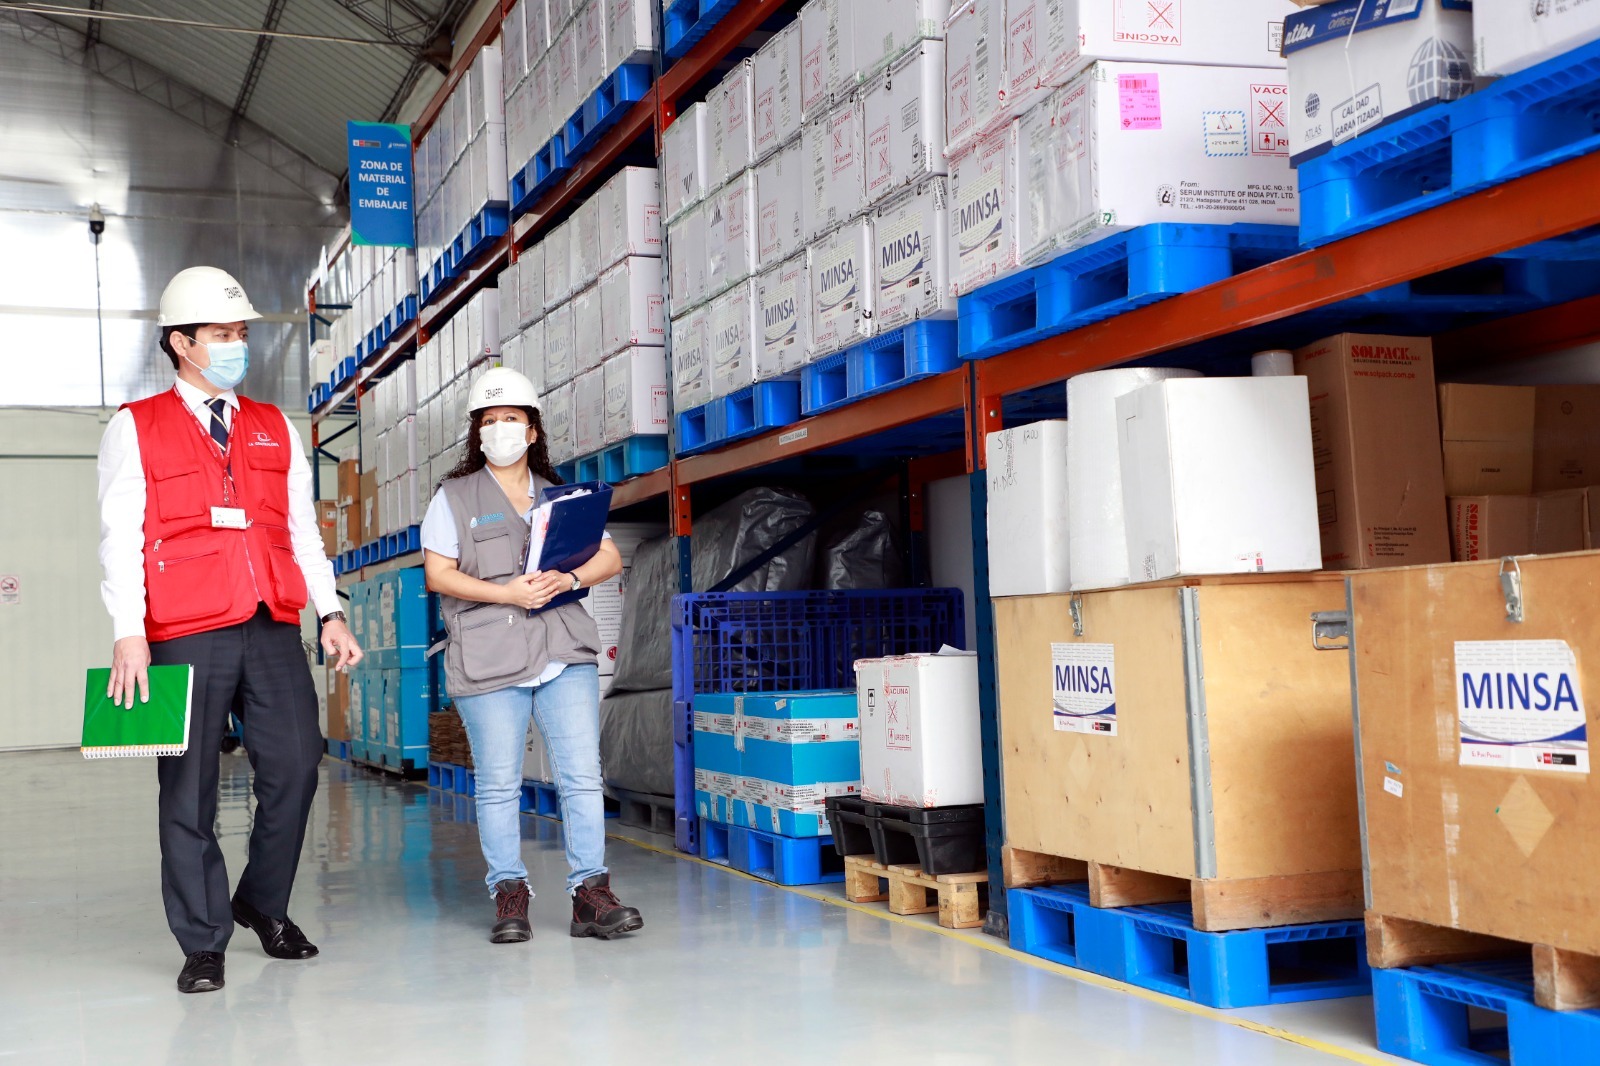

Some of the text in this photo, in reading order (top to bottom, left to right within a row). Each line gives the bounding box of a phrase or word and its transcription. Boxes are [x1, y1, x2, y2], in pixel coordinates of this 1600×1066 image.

[1012, 22, 1026, 36] RUSH
[1284, 23, 1316, 45] atlas
[1328, 16, 1353, 30] Office
[1116, 32, 1179, 44] VACCINE
[1012, 65, 1036, 87] VACCINE
[1062, 86, 1086, 108] ACCINE
[1305, 124, 1322, 138] ATLAS
[360, 160, 403, 171] ZONA DE
[358, 173, 406, 184] MATERIAL
[376, 187, 389, 196] DE
[358, 198, 408, 210] EMBALAJE
[960, 187, 1000, 234] MINSA
[882, 230, 921, 269] MINSA
[820, 258, 855, 293] MINSA
[765, 297, 795, 328] MINSA
[715, 323, 740, 352] MINSA
[678, 347, 702, 373] MINSA
[1352, 345, 1410, 360] SOLPACK
[1354, 370, 1415, 379] www.solpack.com.pe
[1056, 665, 1112, 694] MINSA
[1462, 672, 1579, 712] MINSA
